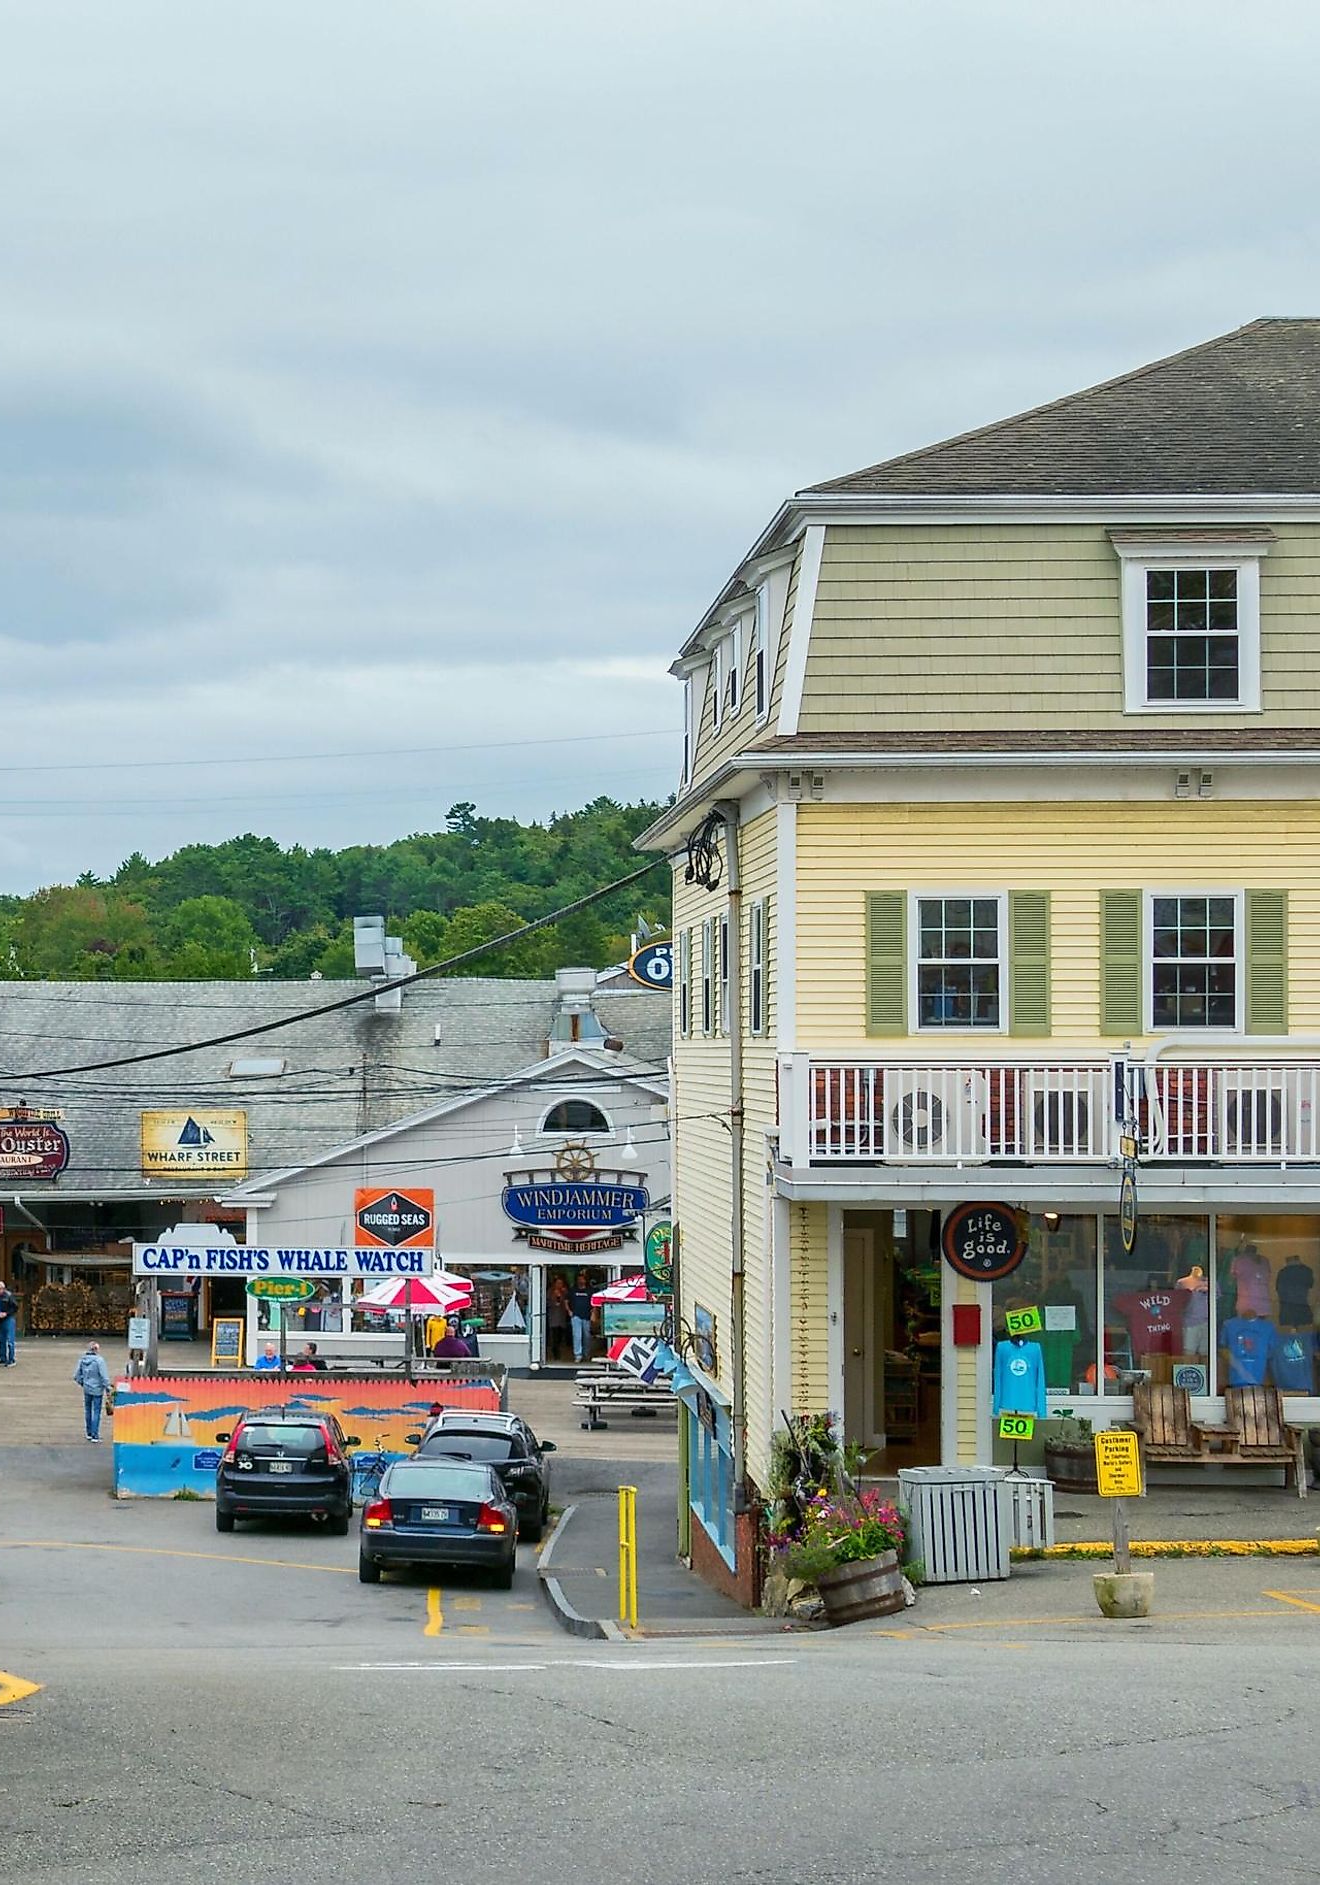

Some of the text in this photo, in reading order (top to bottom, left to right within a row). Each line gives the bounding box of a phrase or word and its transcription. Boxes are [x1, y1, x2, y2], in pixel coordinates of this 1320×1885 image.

[14, 1126, 40, 1138] World
[0, 1136, 61, 1154] Oyster
[147, 1151, 241, 1162] WHARF STREET
[517, 1189, 634, 1209] WINDJAMMER
[363, 1213, 426, 1226] RUGGED SEAS
[537, 1208, 612, 1220] EMPORIUM
[967, 1213, 1002, 1233] Life
[531, 1236, 621, 1253] MARITIME HERITAGE
[979, 1231, 996, 1243] is
[962, 1239, 1011, 1260] good.
[142, 1248, 424, 1272] CAP'n FISH'S WHALE WATCH
[1139, 1295, 1171, 1310] WILD
[1009, 1312, 1034, 1330] 50
[1147, 1322, 1171, 1333] THING
[1002, 1418, 1027, 1434] 50
[1100, 1437, 1132, 1445] Customer
